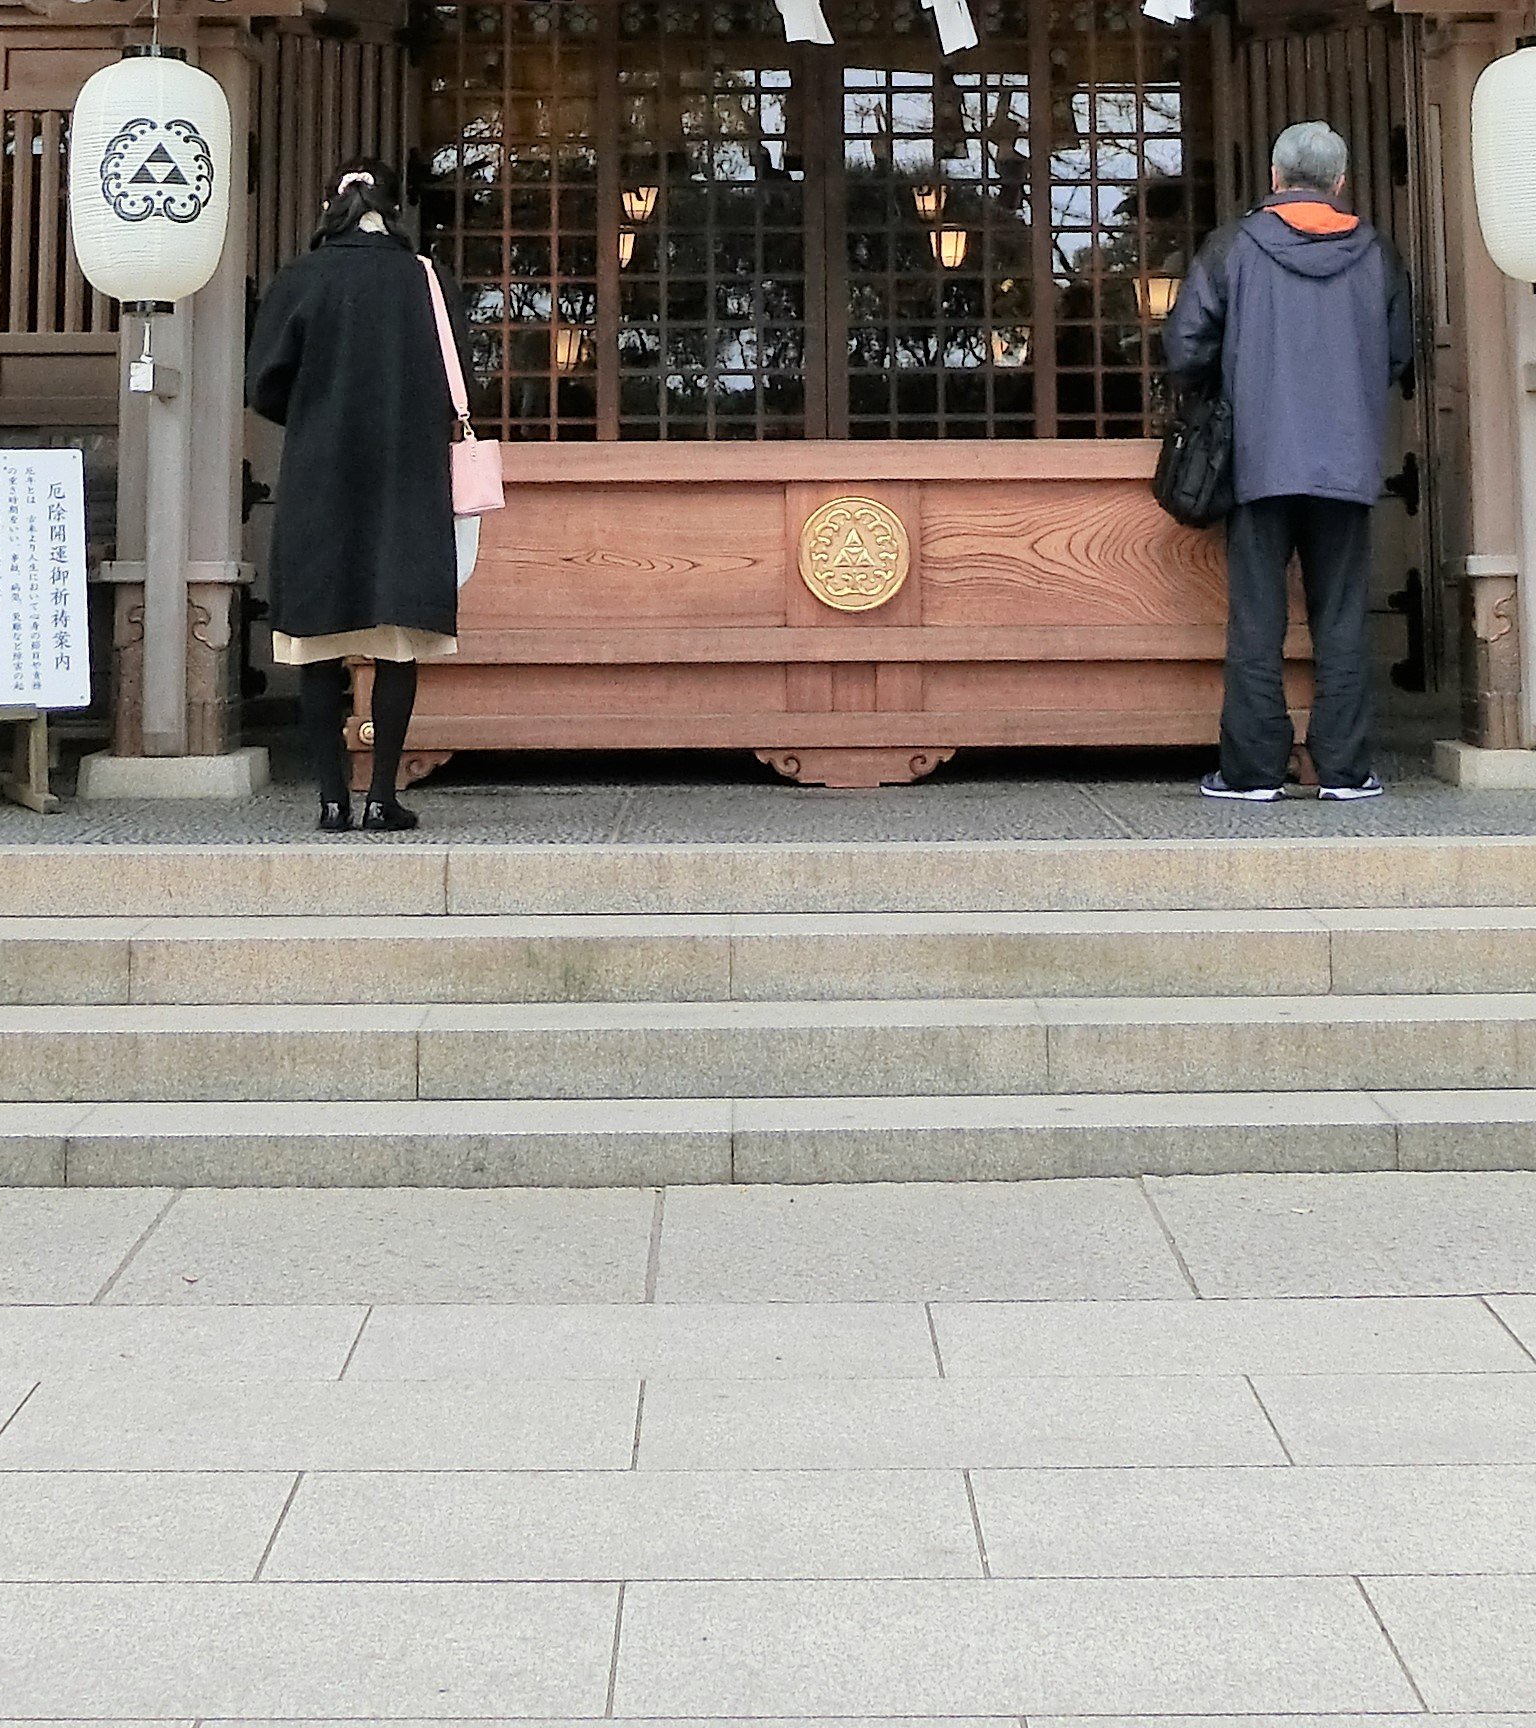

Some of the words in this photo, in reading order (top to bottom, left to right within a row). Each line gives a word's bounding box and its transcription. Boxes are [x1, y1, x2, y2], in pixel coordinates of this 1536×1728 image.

[47, 481, 72, 671] 厄除開運御祈祷案内
